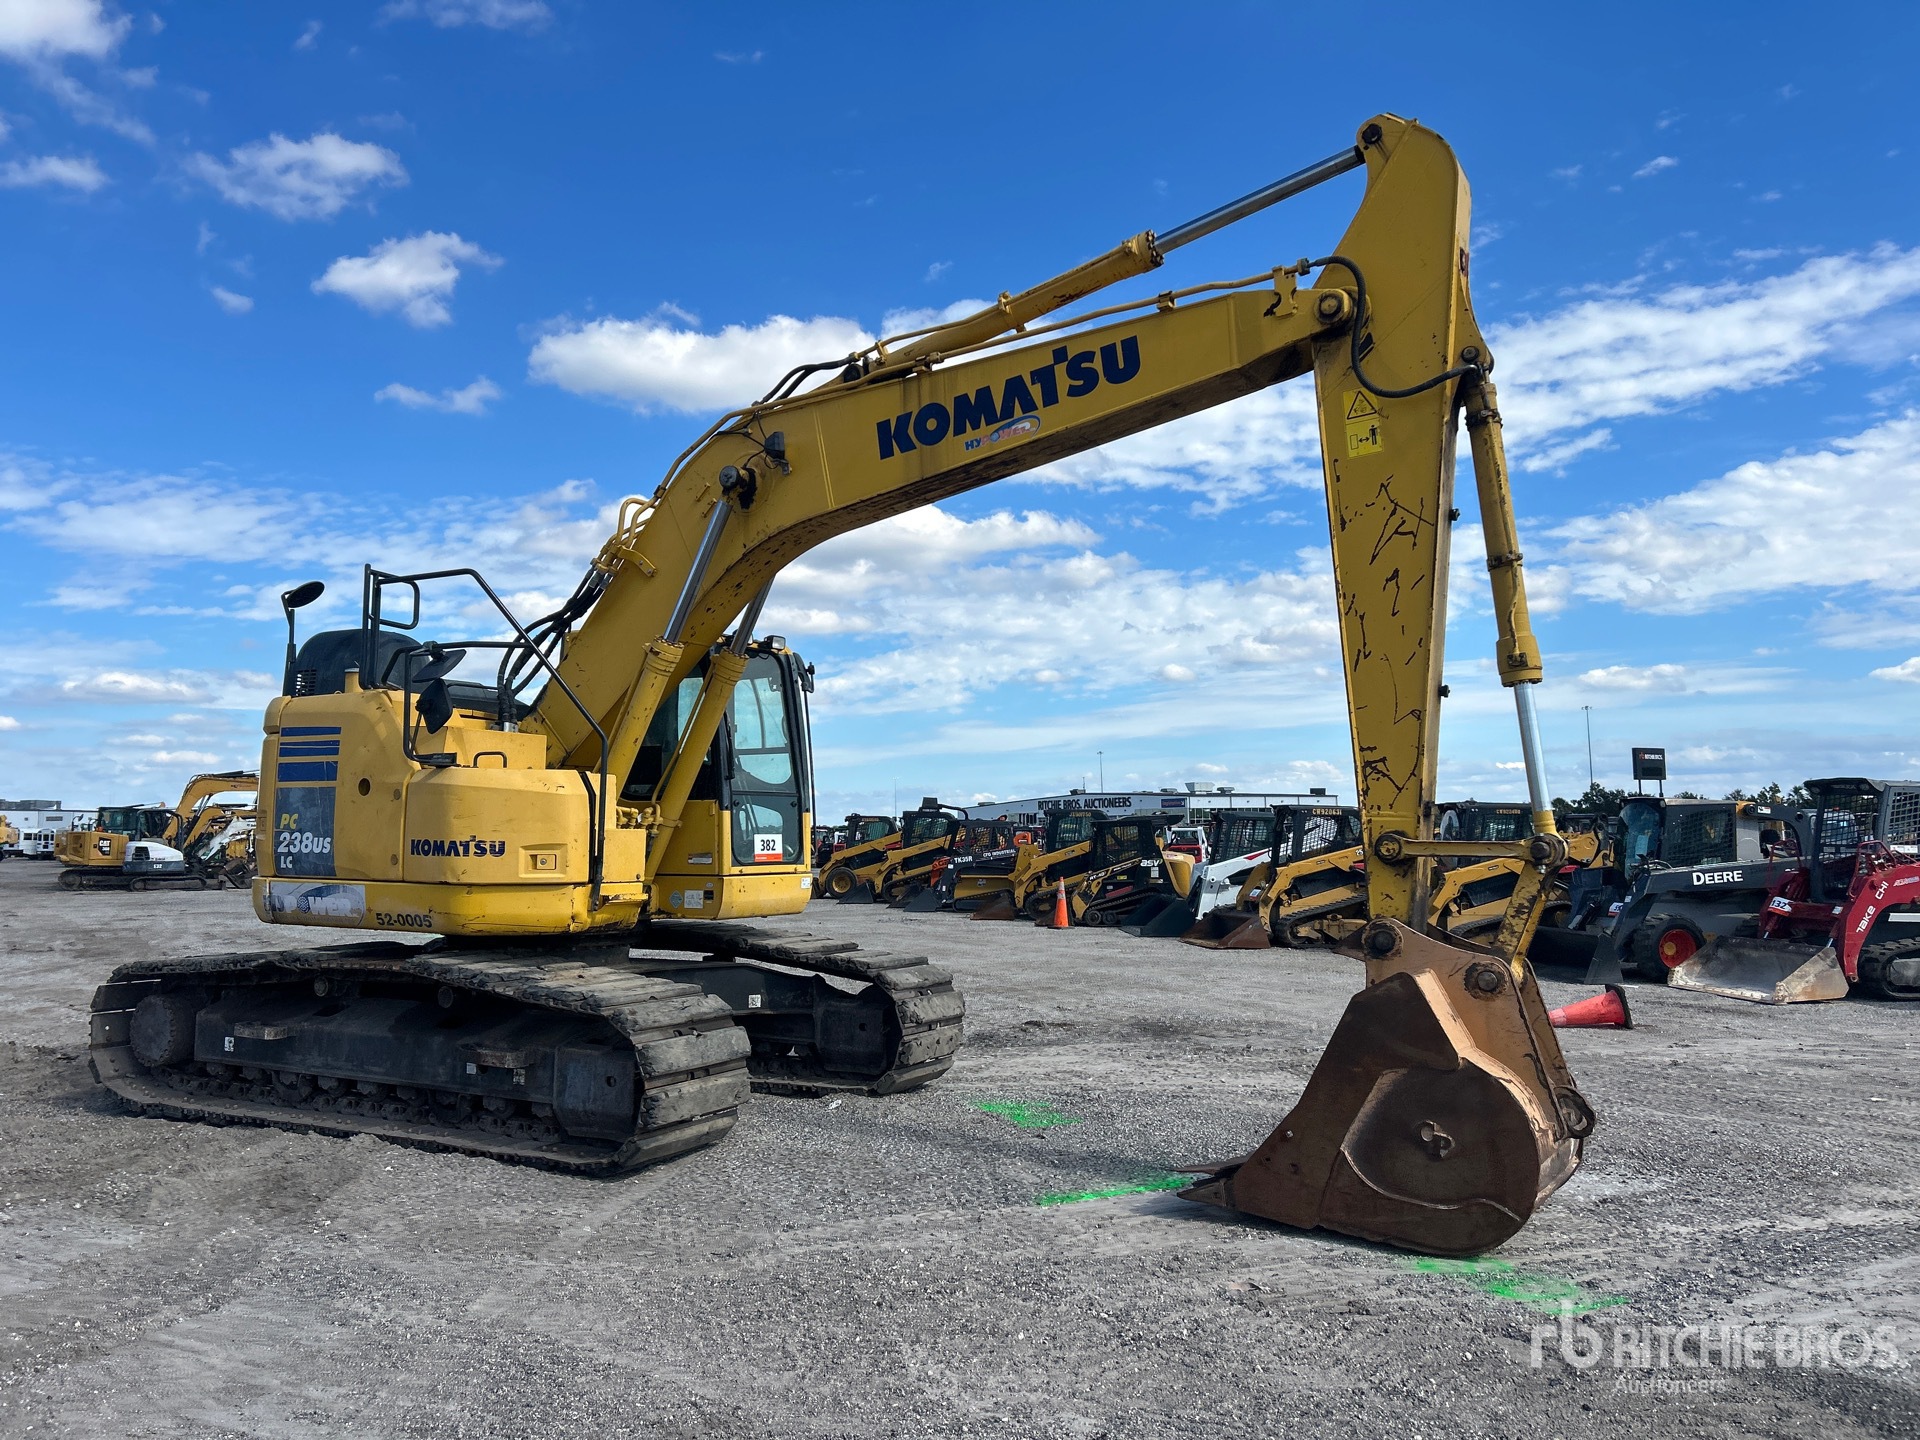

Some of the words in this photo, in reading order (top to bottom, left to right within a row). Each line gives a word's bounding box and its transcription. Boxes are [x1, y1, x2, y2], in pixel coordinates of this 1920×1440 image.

[876, 335, 1141, 460] KOMATSU
[1038, 800, 1061, 810] RITCHIE
[1063, 799, 1082, 810] BROS.
[1084, 797, 1132, 809] AUCTIONEERS
[279, 813, 299, 830] PC
[277, 831, 332, 854] 238US
[410, 835, 505, 858] KOMATSU
[760, 839, 776, 852] 382
[280, 855, 293, 869] LC
[954, 855, 973, 864] TK35R
[1692, 870, 1744, 886] DEERE
[375, 912, 433, 929] 52-0005
